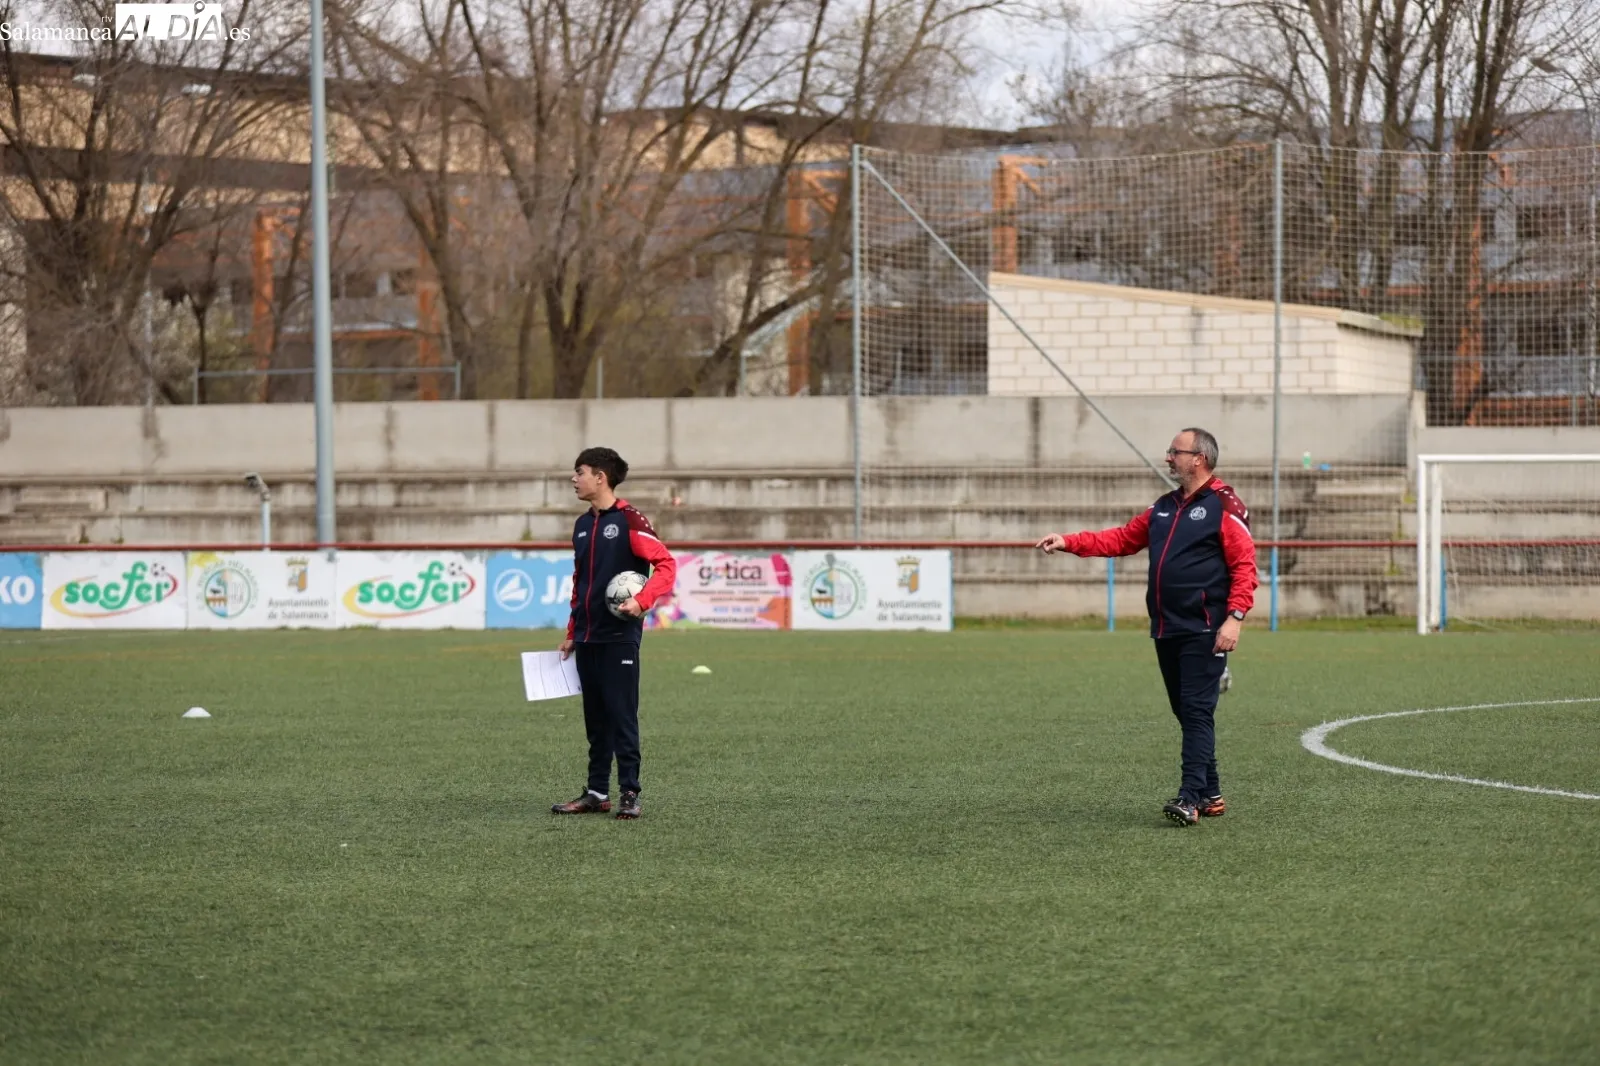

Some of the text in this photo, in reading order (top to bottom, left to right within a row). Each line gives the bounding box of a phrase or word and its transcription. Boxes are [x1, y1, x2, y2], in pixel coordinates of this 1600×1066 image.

[64, 561, 171, 610] socfer
[357, 561, 468, 610] socfer
[268, 597, 329, 608] Ayuntamiento
[877, 598, 942, 609] Ayuntamiento
[268, 610, 329, 620] de Salamanca
[877, 612, 942, 622] de Salamanca
